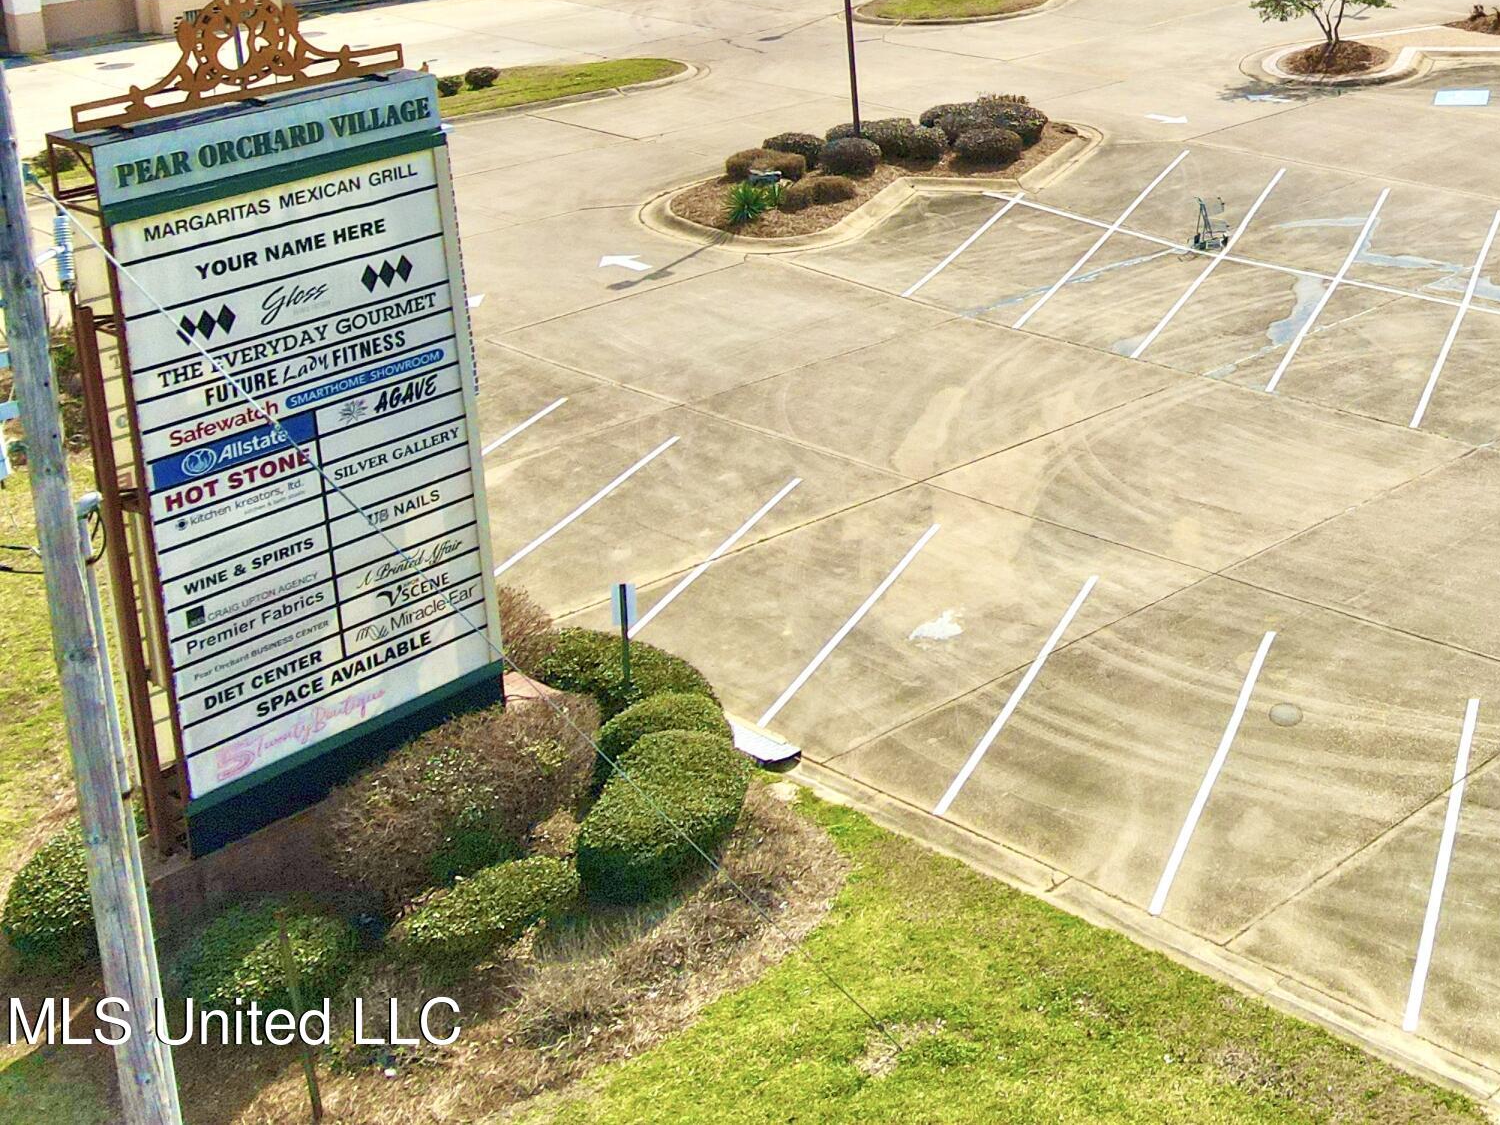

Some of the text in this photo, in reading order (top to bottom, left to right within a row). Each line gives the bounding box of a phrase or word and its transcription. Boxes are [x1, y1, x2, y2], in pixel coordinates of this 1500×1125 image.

[115, 97, 431, 189] PEAR ORCHARD VILLAGE
[143, 164, 418, 242] MARGARITAS MEXICAN GRILL
[195, 218, 387, 280] YOUR NAME HERE
[261, 284, 329, 326] Gloss
[157, 292, 437, 388] THE EVERYDAY GOURMET
[204, 330, 406, 406] FUTURE Lady FITNESS
[169, 351, 441, 448] Safewatch SMARTHOME SHOWROOM
[374, 373, 438, 414] AGAVE
[217, 428, 288, 463] Allstate
[334, 427, 460, 481] SILVER GALLERY
[164, 478, 220, 512] HOT
[227, 448, 311, 490] STONE
[393, 489, 440, 517] NAILS
[190, 505, 233, 526] kitchen
[183, 537, 315, 596] WINE & SPIRITS
[374, 549, 425, 582] Printed
[186, 591, 325, 655] Premier Fabrics
[207, 602, 240, 622] CRAIG
[278, 572, 319, 594] AGENCY
[250, 634, 295, 658] BUSINESS
[295, 620, 330, 639] CENTER
[203, 650, 323, 711] DIET CENTER
[256, 630, 433, 718] SPACE AVAILABLE
